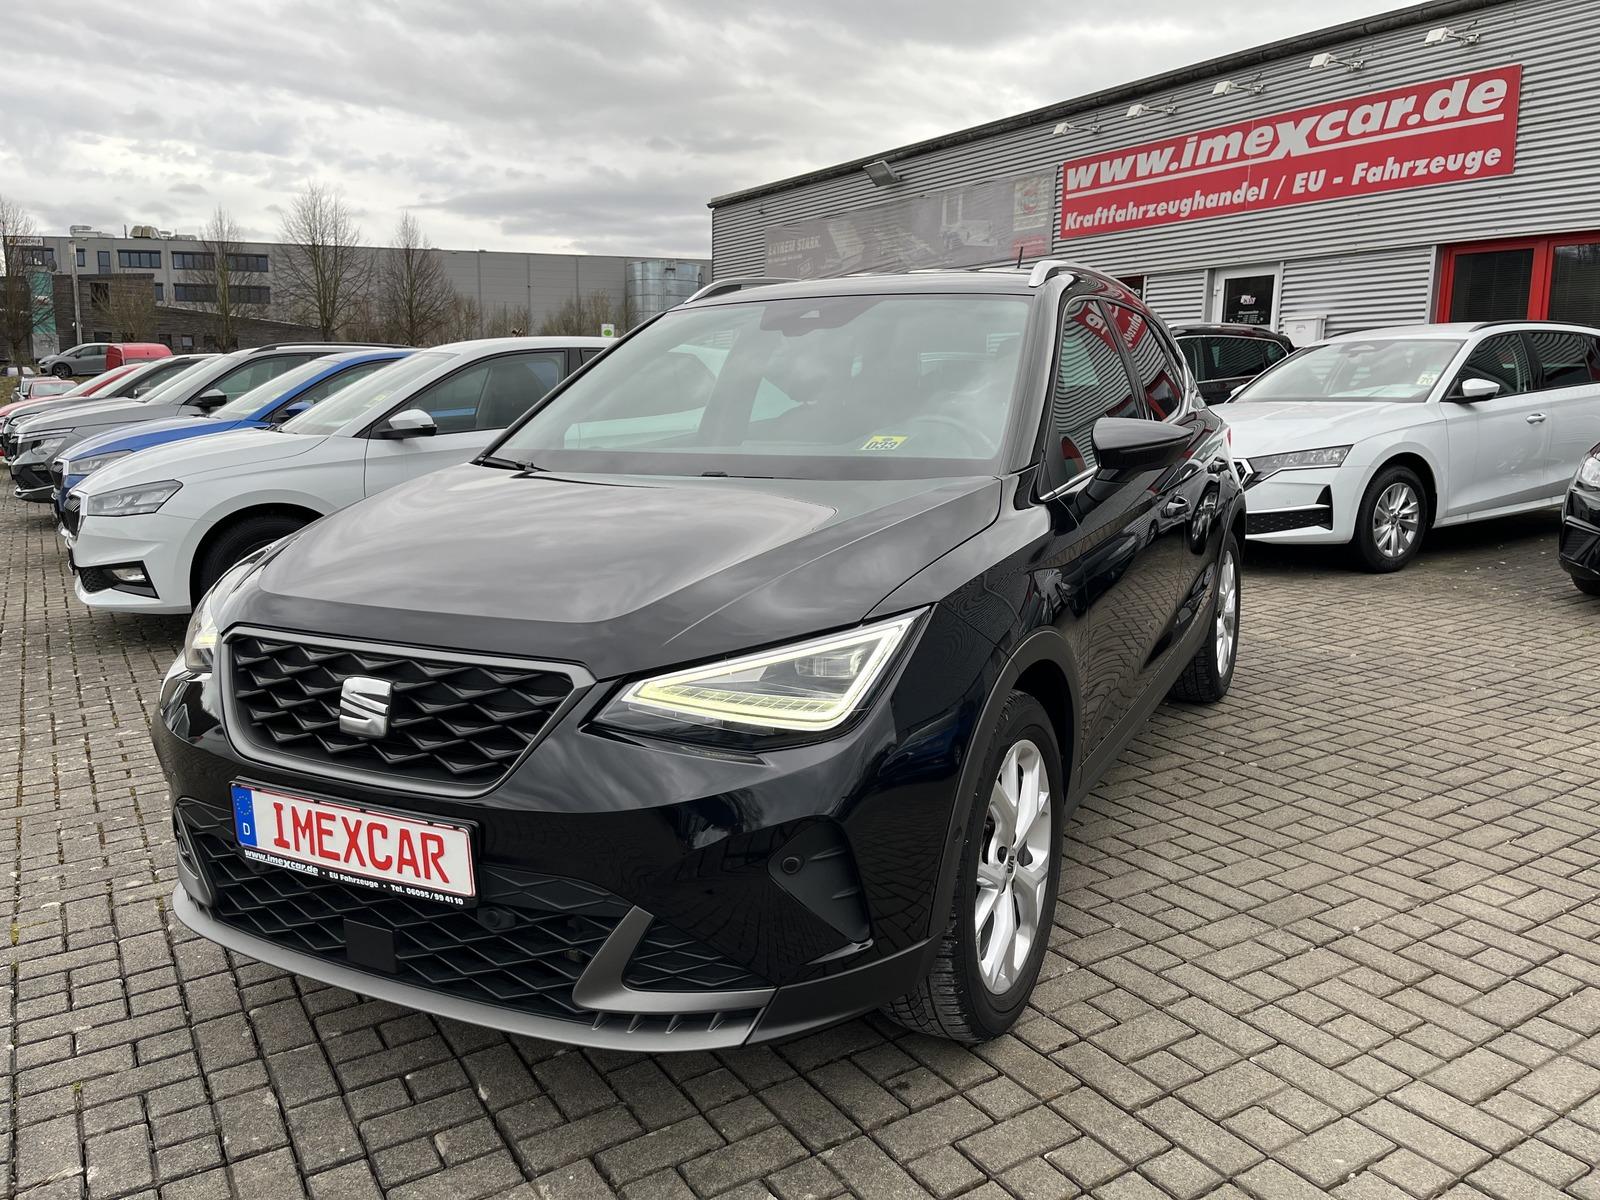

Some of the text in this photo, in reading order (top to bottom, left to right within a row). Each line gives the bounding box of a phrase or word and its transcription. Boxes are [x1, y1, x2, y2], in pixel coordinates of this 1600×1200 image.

[1065, 178, 1268, 231] Kraftfahrzeughandel
[1273, 175, 1288, 200] /
[1292, 168, 1327, 196] EU
[1352, 147, 1502, 186] Fahrzeuge
[243, 822, 251, 836] D
[273, 802, 449, 884] IMEXCAR
[329, 872, 339, 880] EU
[340, 873, 379, 888] Fahrzeuge
[390, 884, 405, 893] Tel.
